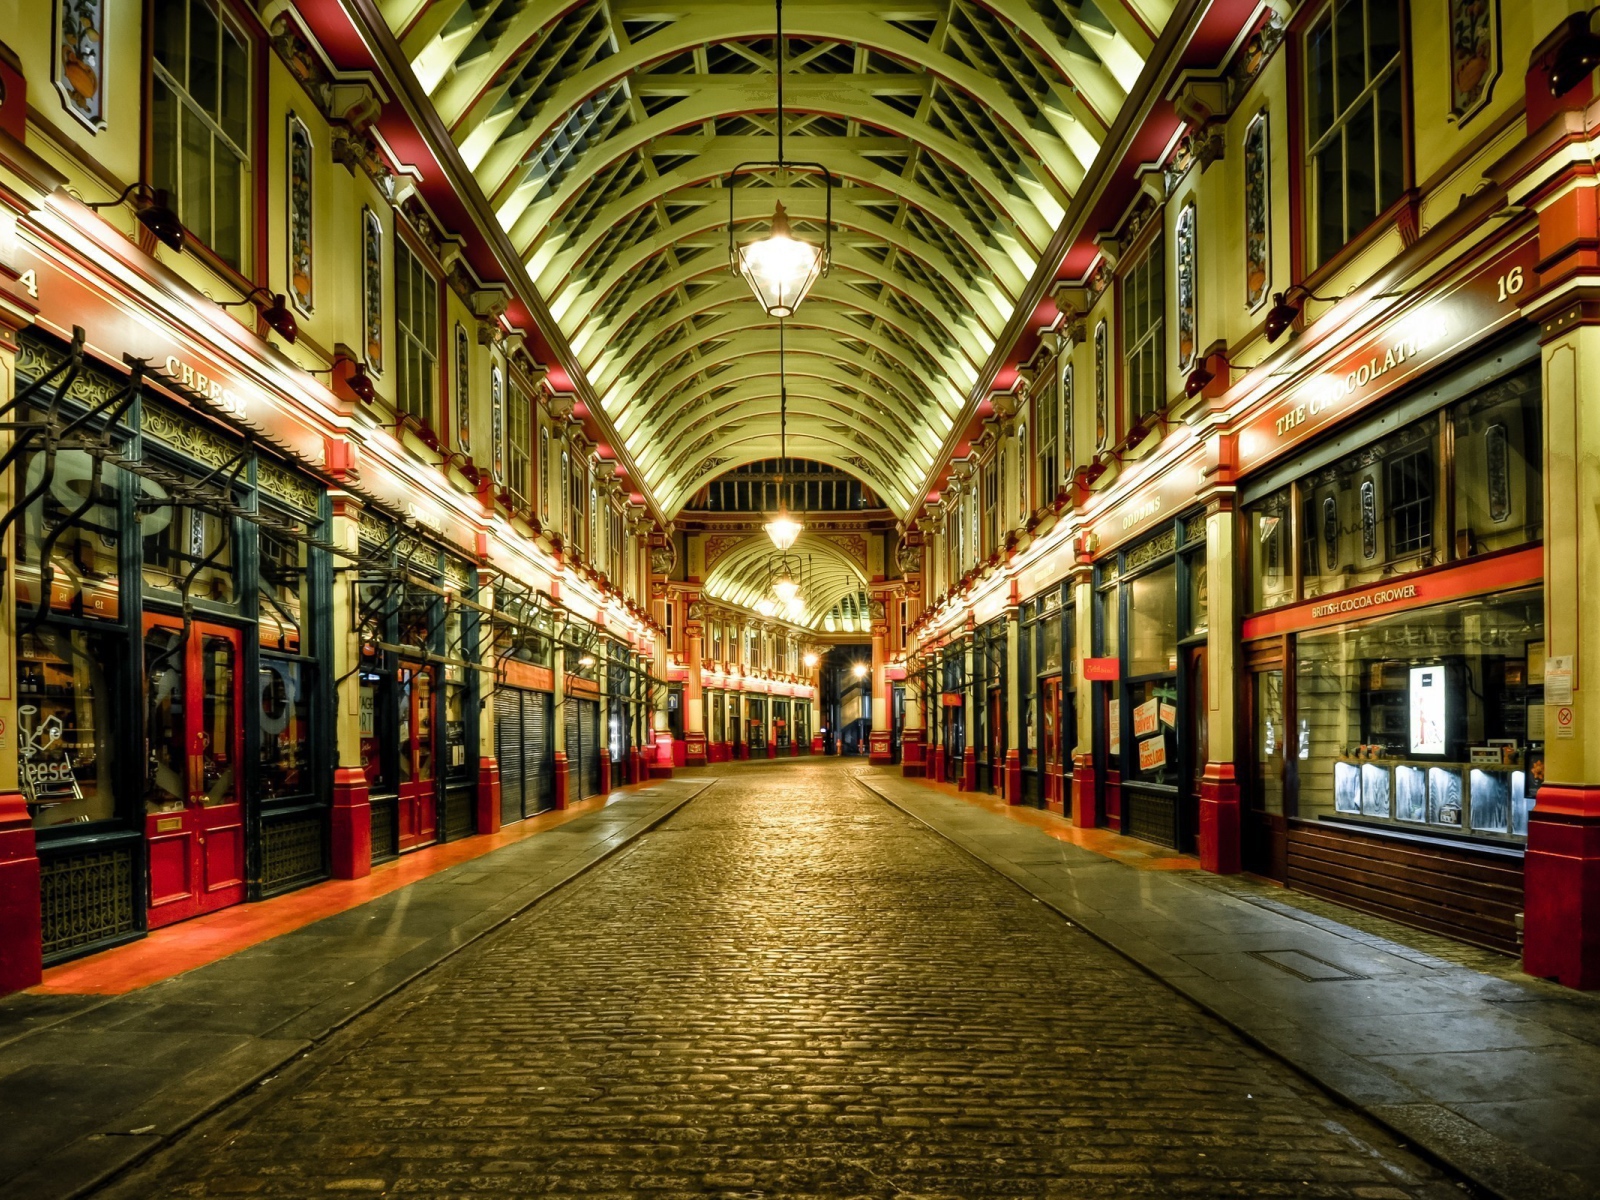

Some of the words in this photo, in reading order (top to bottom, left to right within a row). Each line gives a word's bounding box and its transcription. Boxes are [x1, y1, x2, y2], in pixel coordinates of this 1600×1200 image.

[19, 268, 38, 299] 4
[1498, 265, 1524, 302] 16
[165, 355, 248, 419] CHEESE
[1276, 408, 1307, 437] THE
[1311, 602, 1340, 618] BRITISH
[1340, 595, 1373, 612] COCOA
[1374, 584, 1416, 605] GROWER
[1395, 629, 1512, 647] SELECOR
